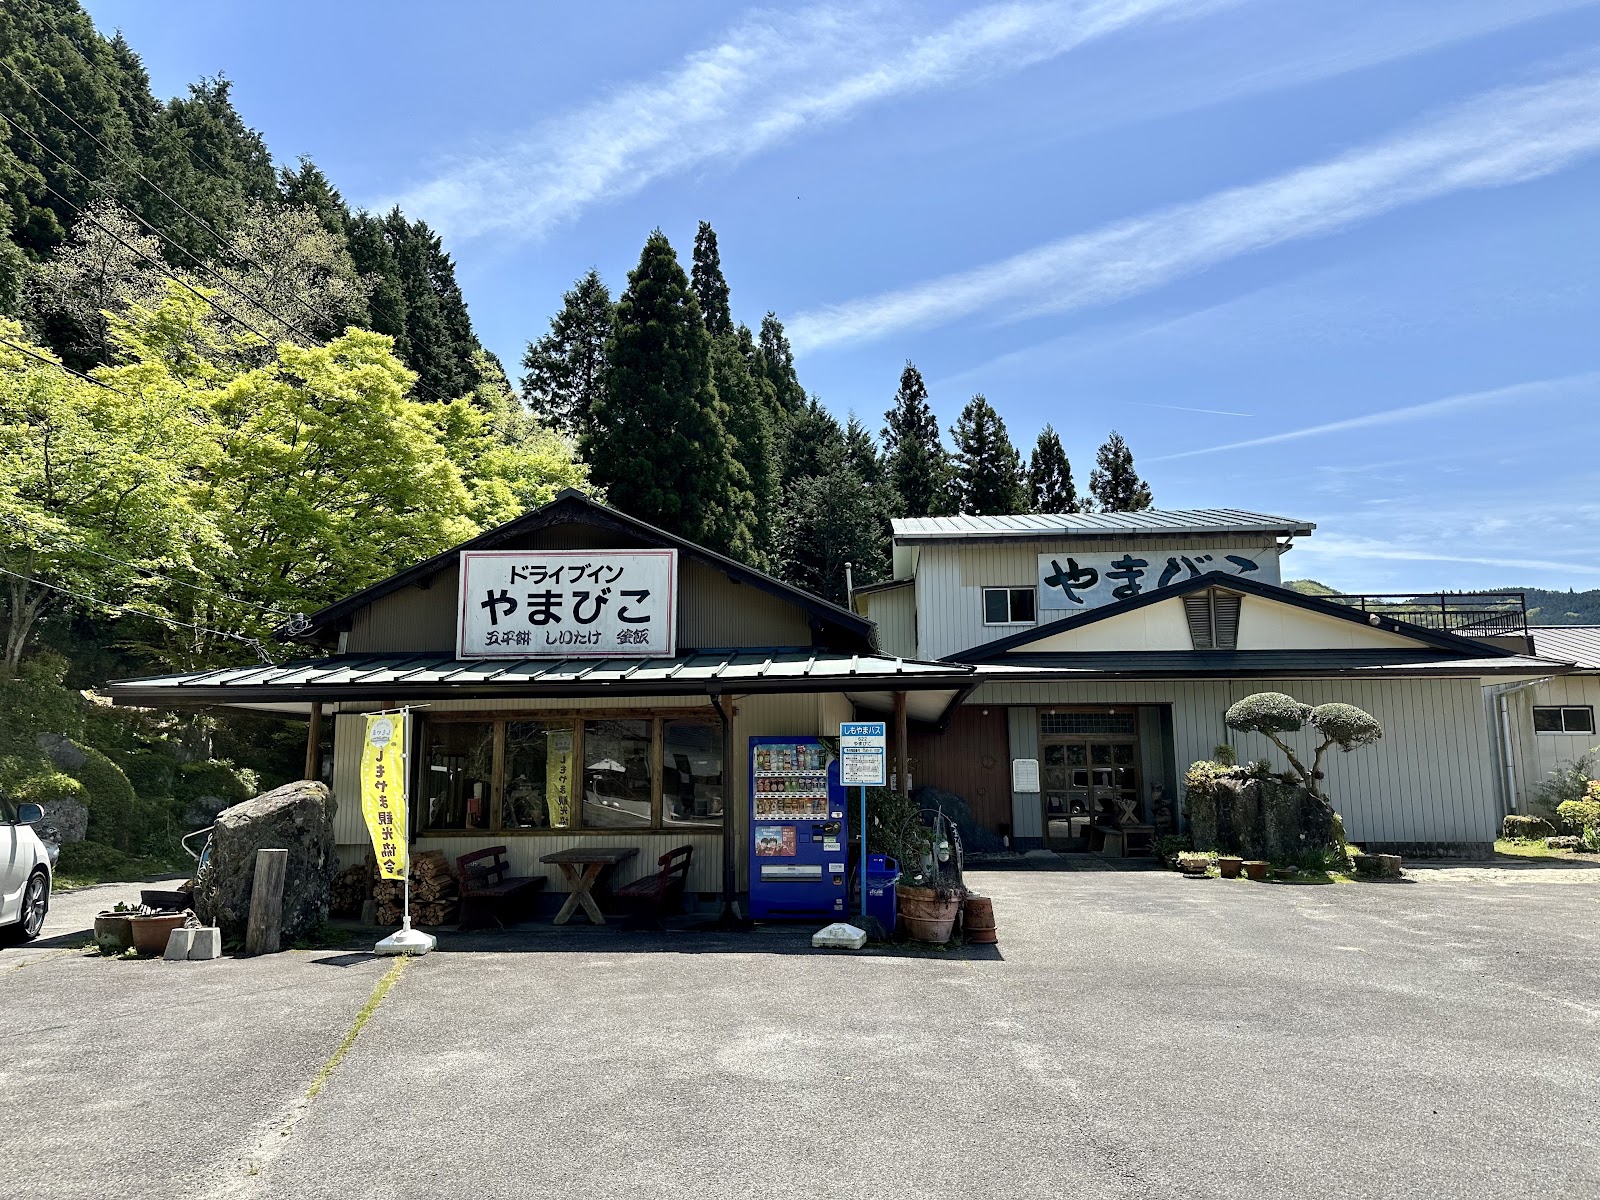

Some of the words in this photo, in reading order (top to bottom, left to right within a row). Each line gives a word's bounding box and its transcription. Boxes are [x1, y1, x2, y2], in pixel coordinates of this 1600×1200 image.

[510, 563, 624, 584] ドライブイン
[481, 587, 651, 625] やまびこ
[484, 629, 532, 647] 五平餅
[545, 629, 602, 646] しいたけ
[616, 628, 650, 645] 釜飯
[844, 726, 881, 734] しもやまバス
